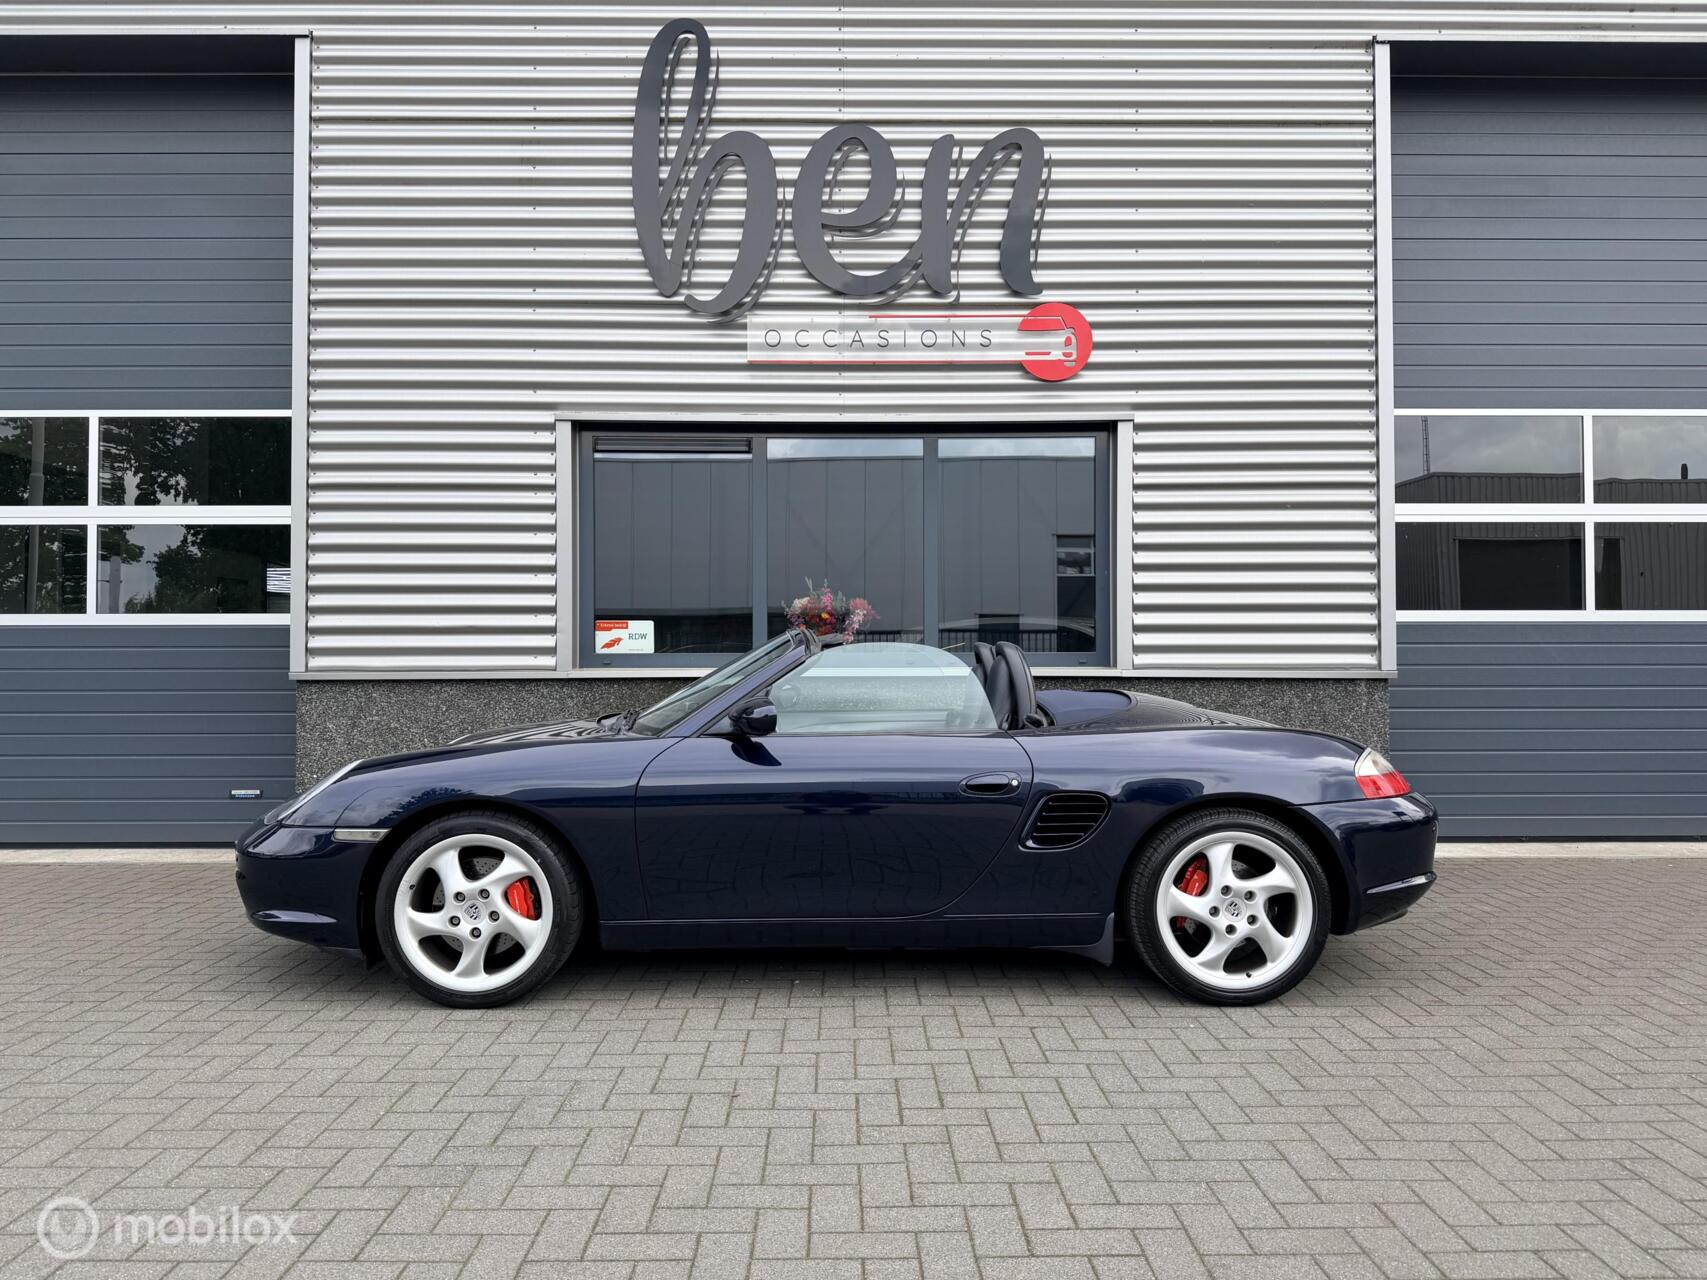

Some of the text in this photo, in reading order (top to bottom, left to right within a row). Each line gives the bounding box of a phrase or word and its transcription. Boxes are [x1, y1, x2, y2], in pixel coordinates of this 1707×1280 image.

[632, 17, 1044, 314] ben
[765, 328, 993, 349] OCCASIONS
[628, 632, 648, 640] RDW
